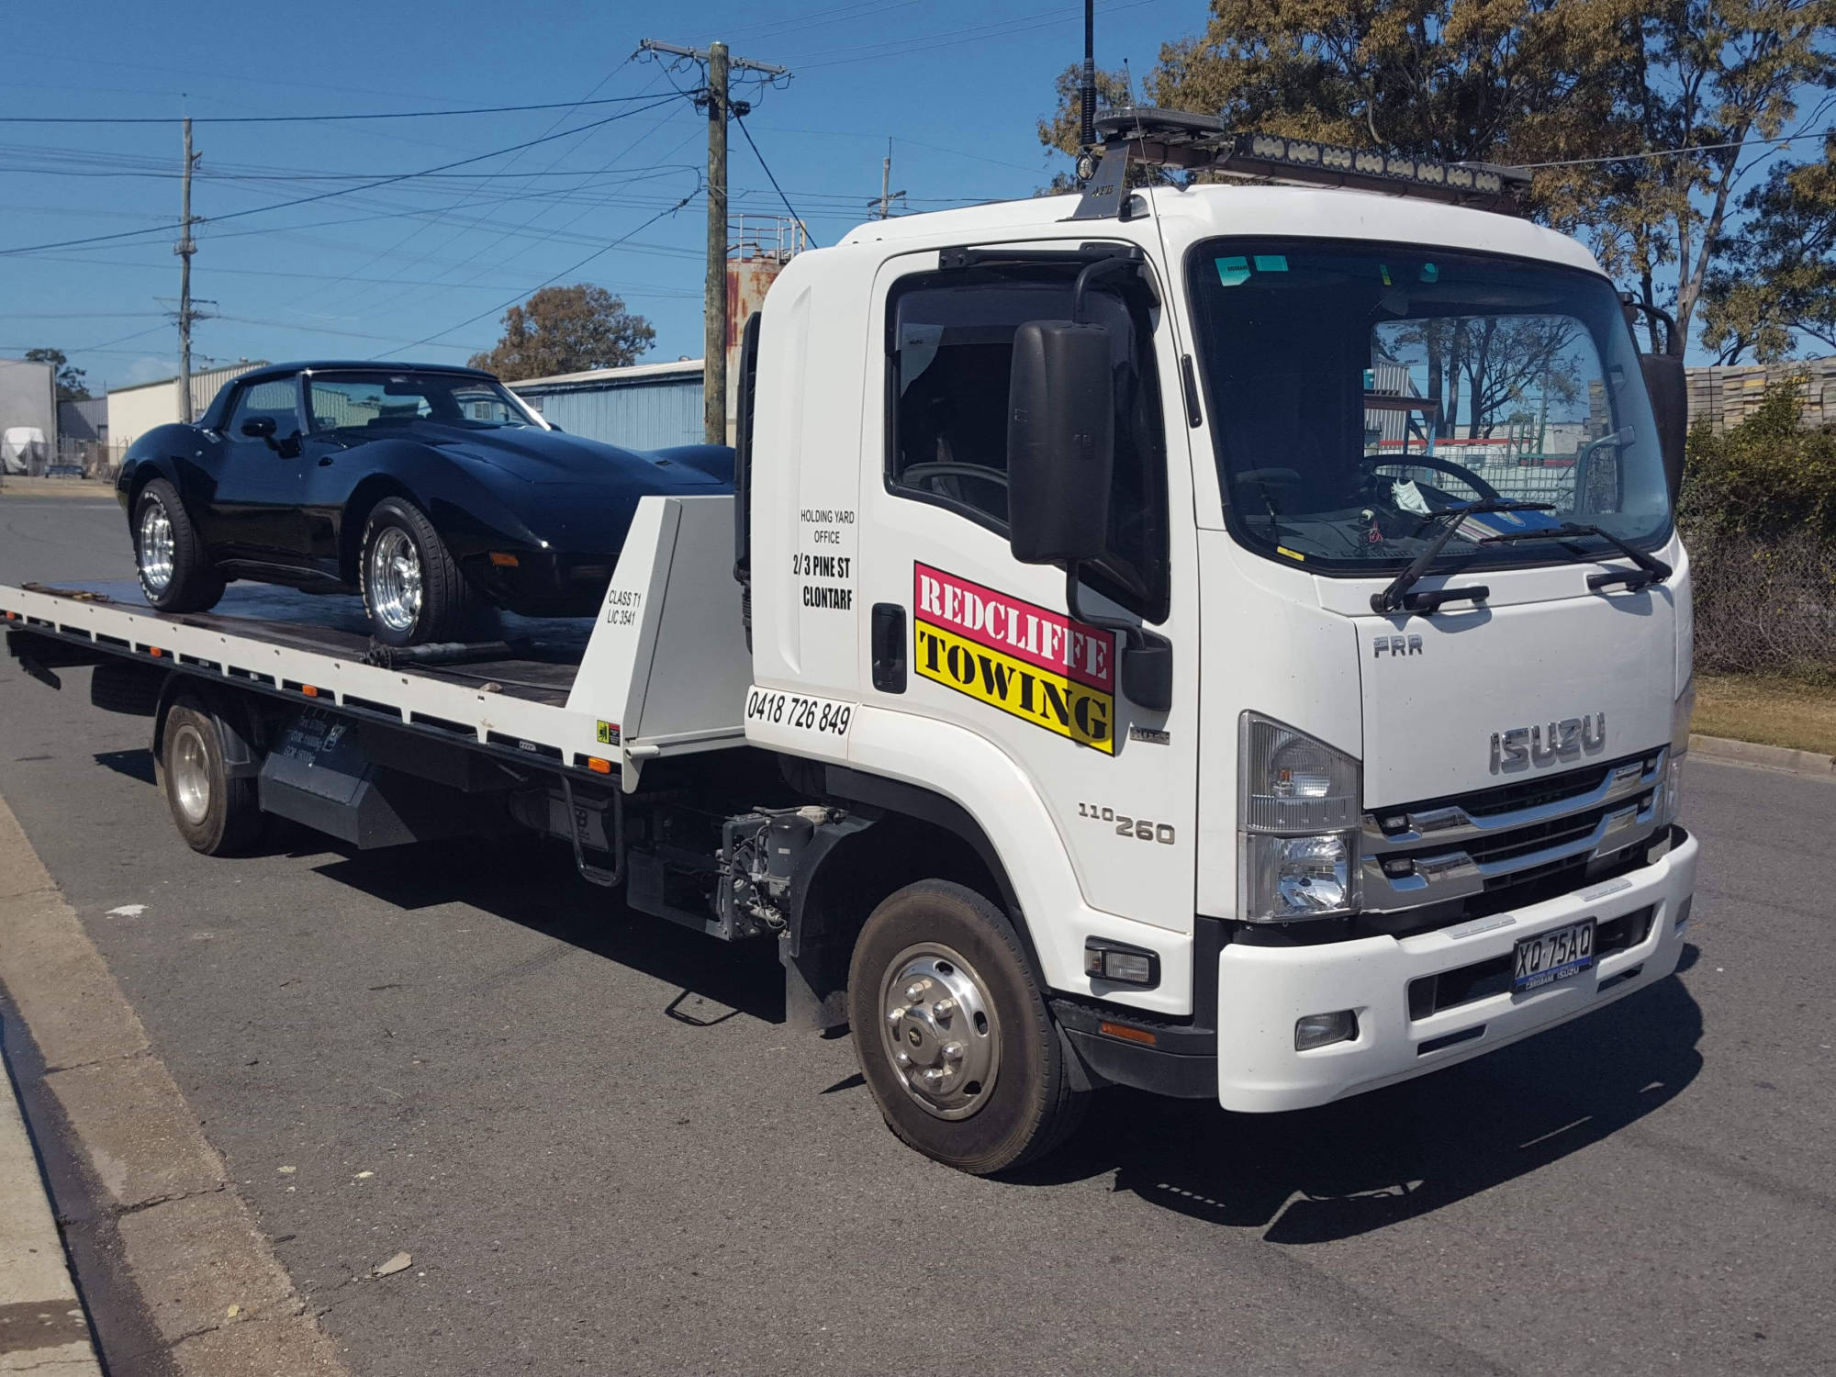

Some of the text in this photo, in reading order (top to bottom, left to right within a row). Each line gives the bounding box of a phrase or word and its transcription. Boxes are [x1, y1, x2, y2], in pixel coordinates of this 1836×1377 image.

[800, 509, 855, 525] HOLDING YARD
[814, 530, 840, 544] OFFICE
[813, 555, 835, 577] PINE
[837, 557, 851, 579] ST
[609, 590, 641, 608] CLASS T1
[803, 585, 853, 611] CLONTARF
[607, 609, 619, 624] LIC
[919, 574, 1108, 681] REDCLIFFE
[1373, 633, 1423, 659] FRR
[919, 630, 1108, 741] TOWING
[747, 691, 851, 736] 0418 726 849
[1489, 711, 1607, 776] ISUZU
[1078, 802, 1176, 845] 110 260
